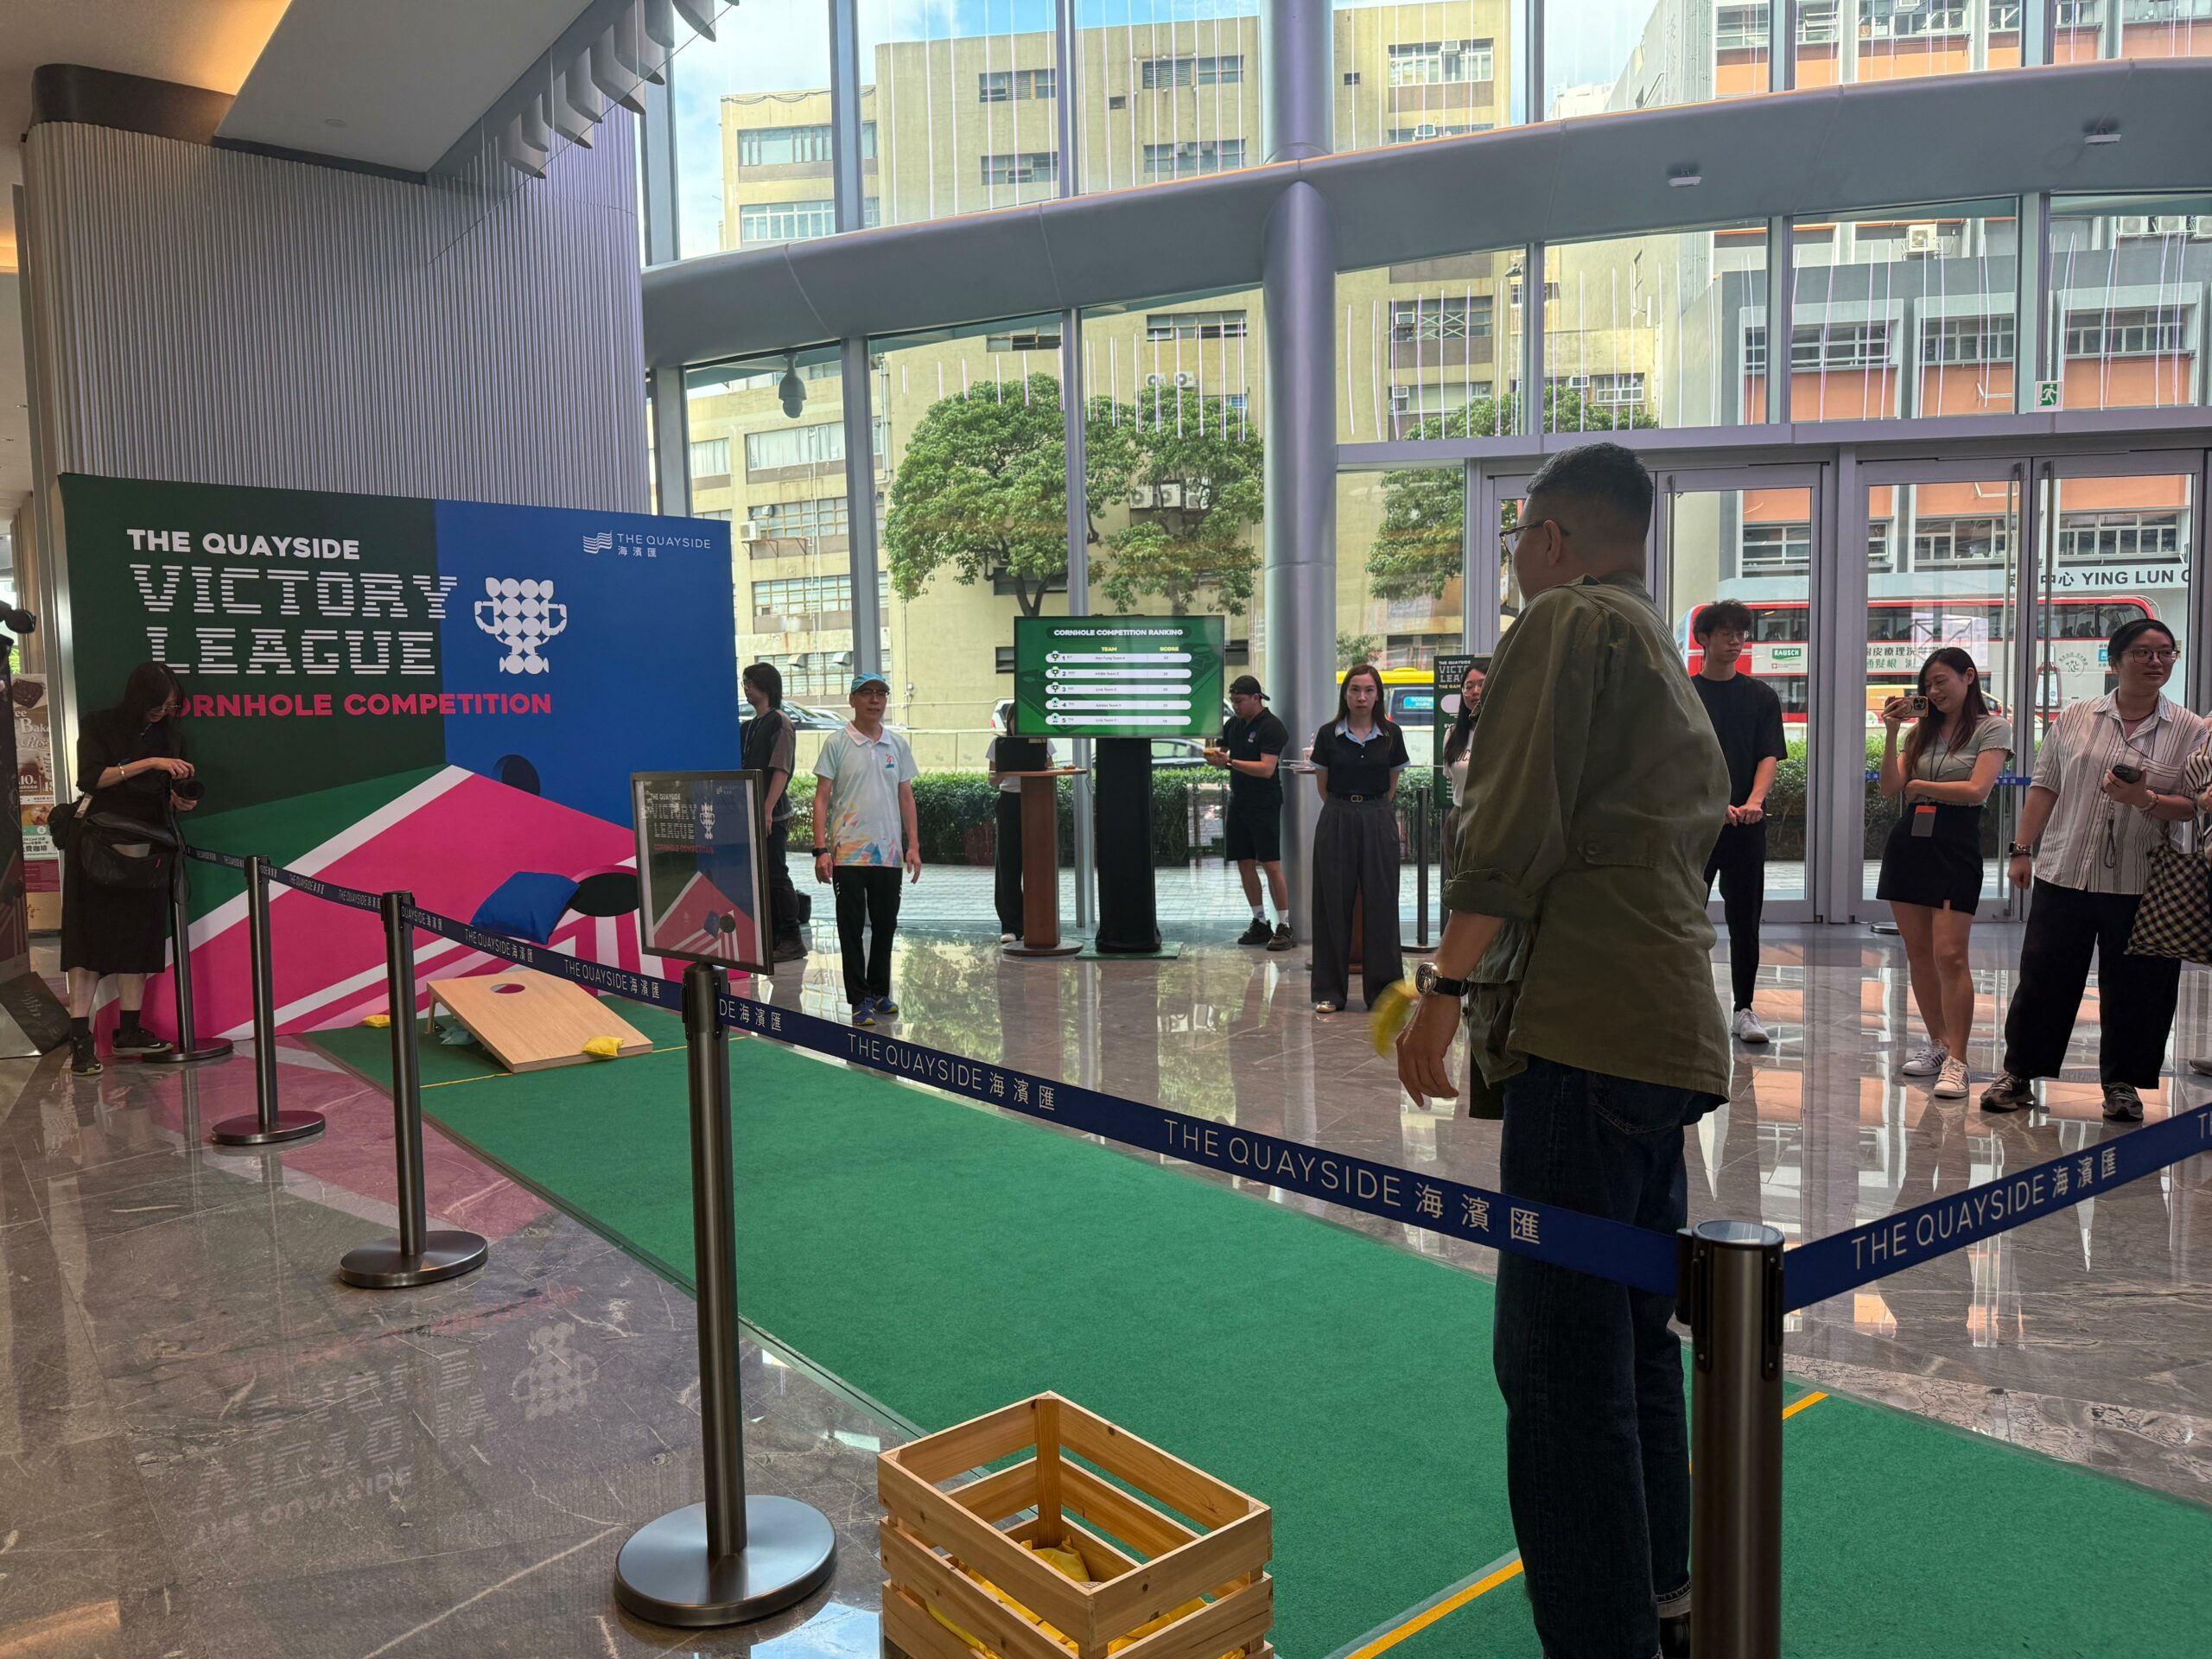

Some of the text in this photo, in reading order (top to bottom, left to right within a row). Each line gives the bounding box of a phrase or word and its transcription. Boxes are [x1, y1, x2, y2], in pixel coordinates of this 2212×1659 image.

[127, 529, 359, 560] THE QUAYSIDE
[617, 533, 710, 549] THE QUAYSIDE
[618, 546, 657, 557] 海濱匯
[2082, 571, 2128, 585] YING
[2135, 569, 2174, 584] LUN
[130, 564, 457, 619] VICTORY
[146, 626, 436, 674] LEAGUE
[180, 694, 551, 716] RNHOLE COMPETITION
[654, 823, 695, 839] LEAGUE
[401, 905, 426, 925] QUAYSIDE
[464, 928, 477, 944] THE
[478, 933, 511, 956] QUAYSIDE
[564, 959, 582, 977] THE
[582, 965, 628, 990] QUAYSIDE
[739, 1005, 782, 1032] 海濱匯
[847, 1033, 1056, 1111] THE QUAYSIDE 海濱匯
[1163, 1118, 1541, 1245] THE QUAYSIDE 海濱匯
[1851, 1147, 2117, 1270] THE QUAYSIDE 海濱匯
